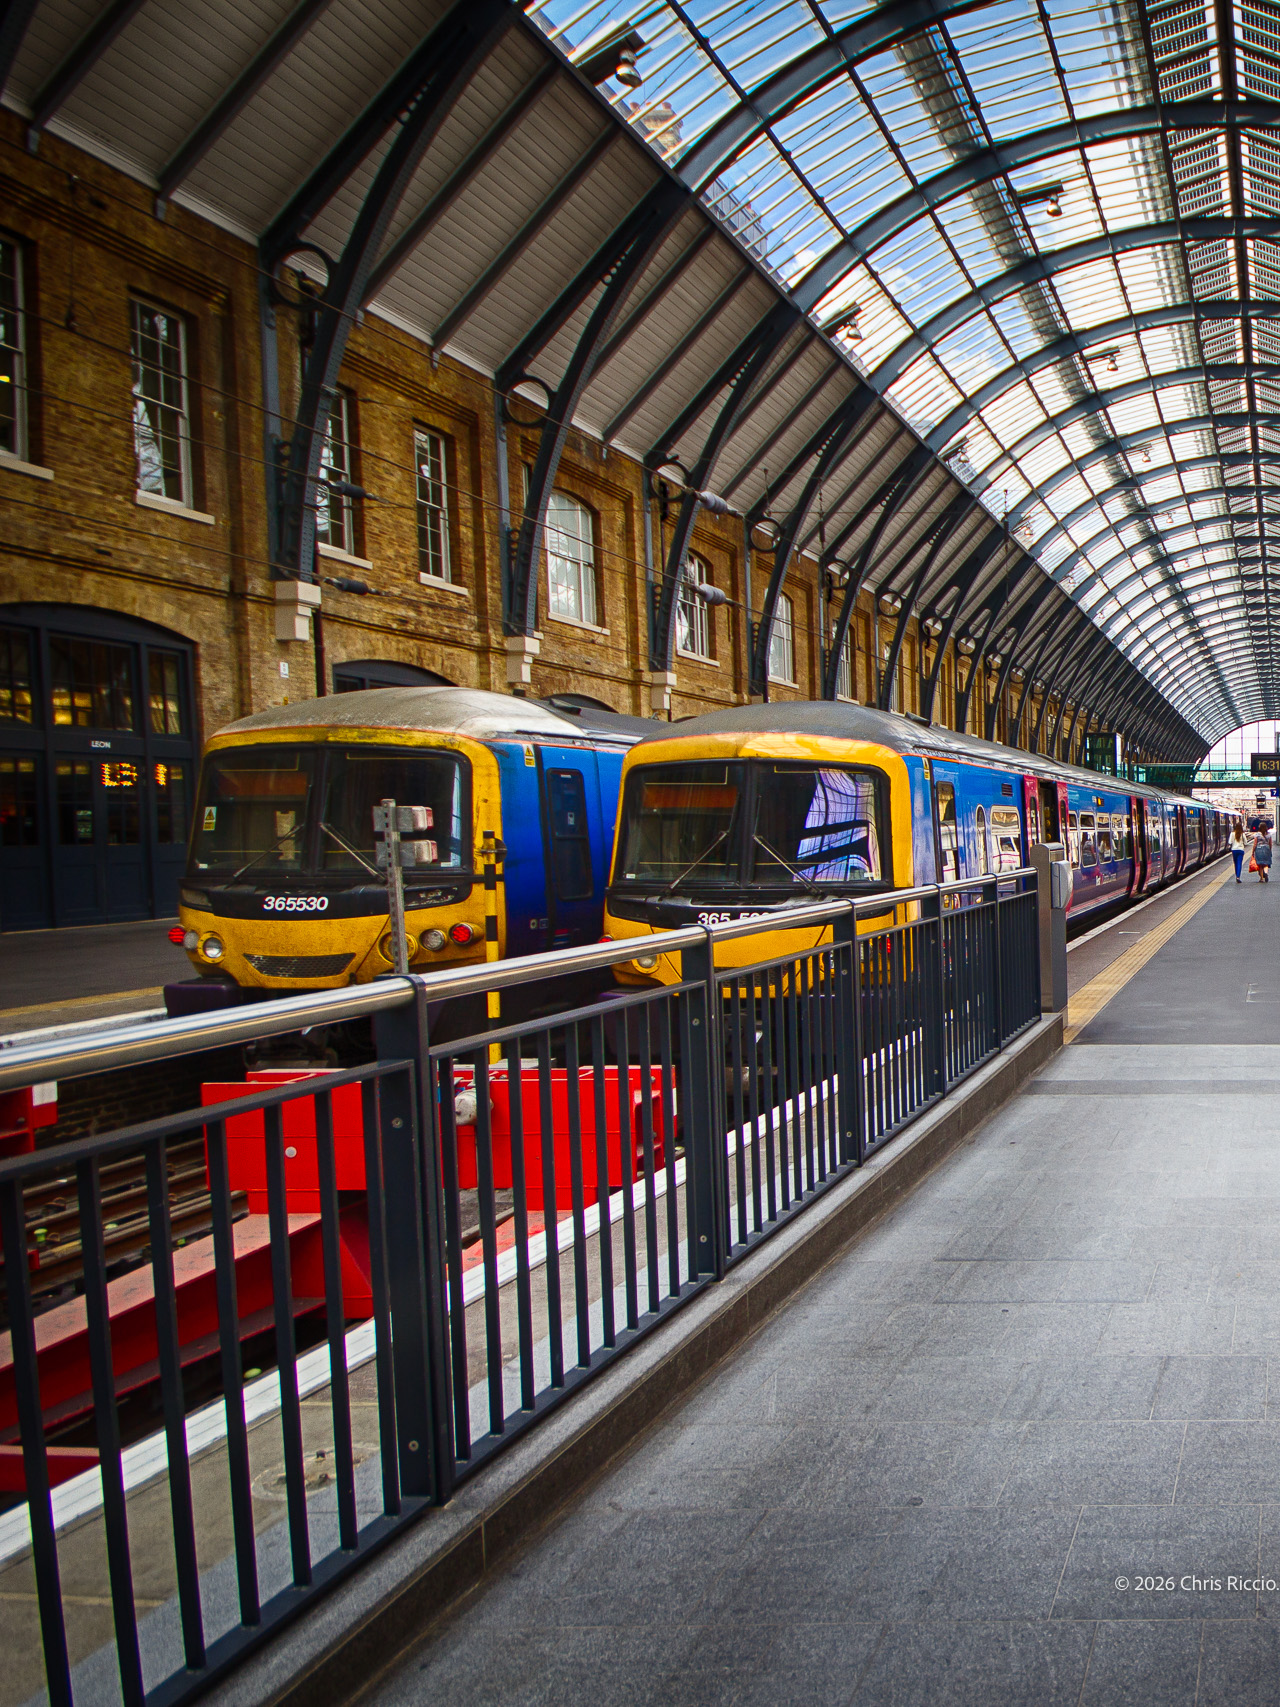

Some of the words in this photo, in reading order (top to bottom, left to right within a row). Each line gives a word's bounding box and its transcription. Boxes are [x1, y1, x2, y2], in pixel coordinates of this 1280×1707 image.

[91, 740, 111, 748] LEON
[1257, 760, 1280, 770] 16:31
[263, 896, 329, 912] 365530
[698, 912, 731, 925] 365
